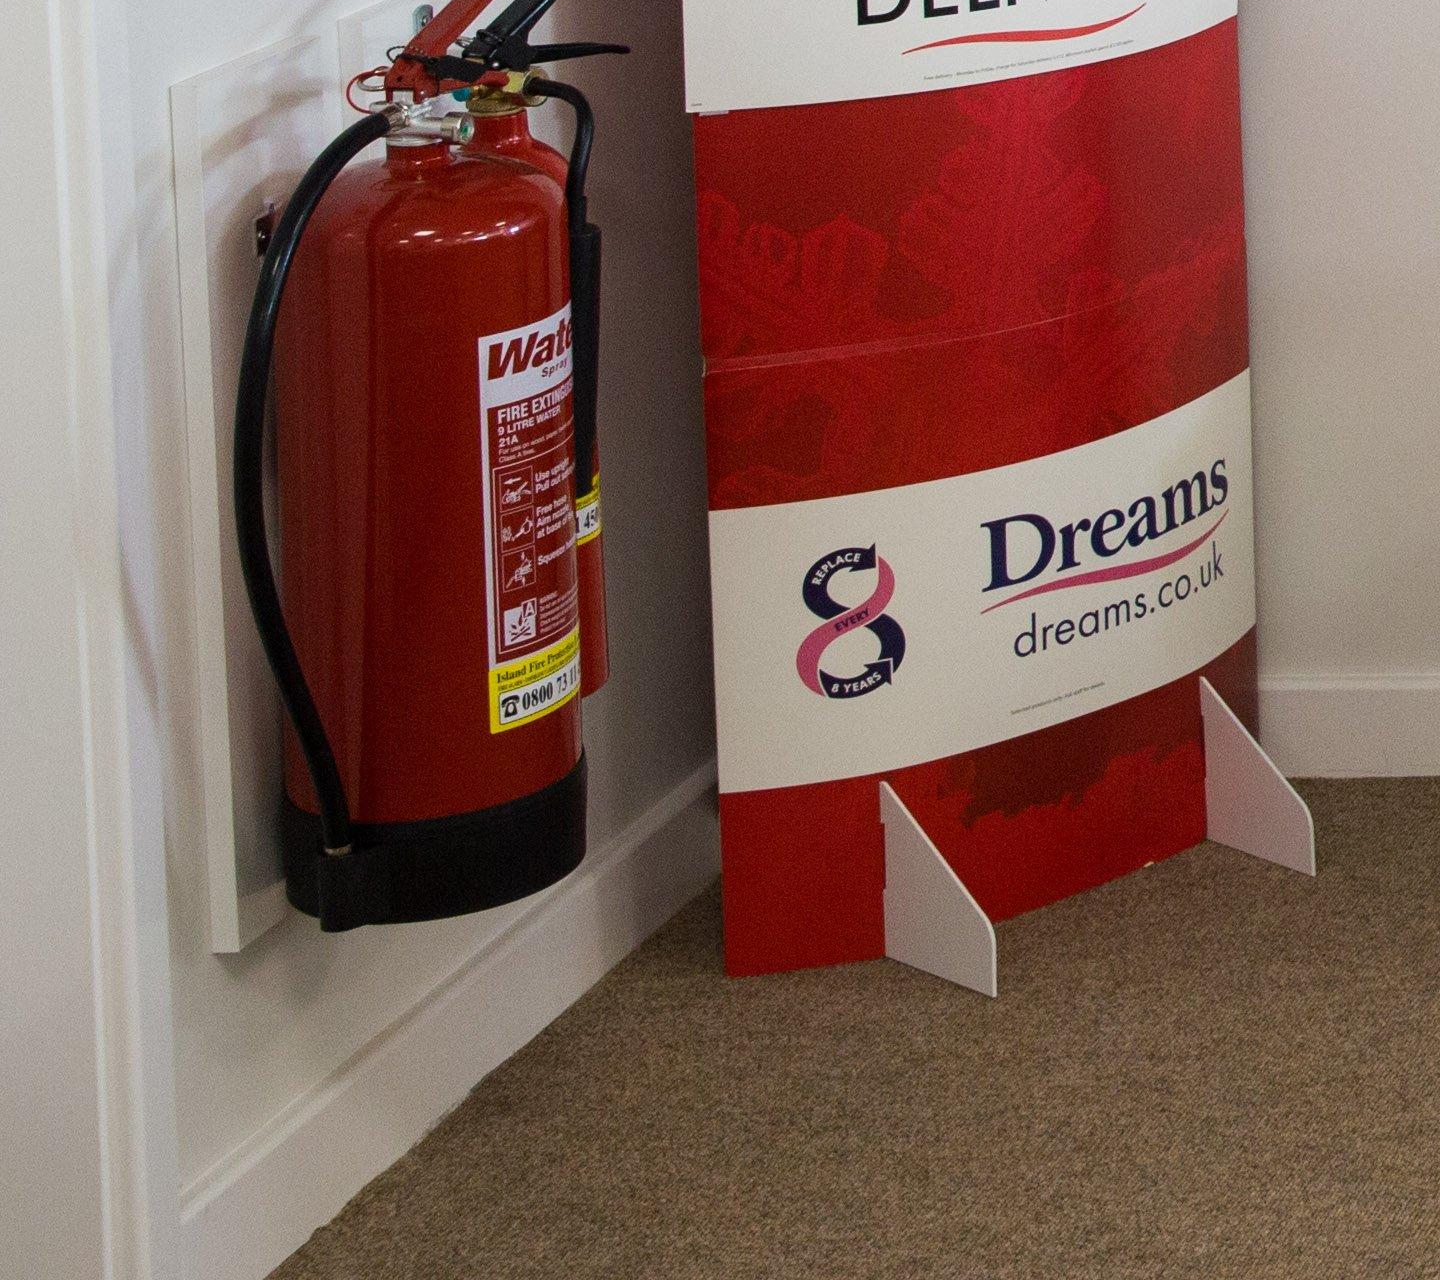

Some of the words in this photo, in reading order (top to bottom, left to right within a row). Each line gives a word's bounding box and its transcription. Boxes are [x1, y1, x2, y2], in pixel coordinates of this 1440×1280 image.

[487, 317, 573, 381] Wate
[541, 357, 568, 378] Spray
[498, 402, 529, 425] FIRE
[507, 419, 535, 433] LITRE
[537, 405, 561, 424] WATER
[499, 435, 519, 447] 21A
[980, 458, 1230, 593] Dreams
[811, 550, 862, 587] REPLACE
[1013, 541, 1225, 659] dreams.co.uk
[833, 608, 871, 633] EVERY
[498, 666, 527, 684] Island
[529, 657, 546, 674] Fire
[844, 669, 883, 694] YEARS
[522, 681, 554, 711] 0800
